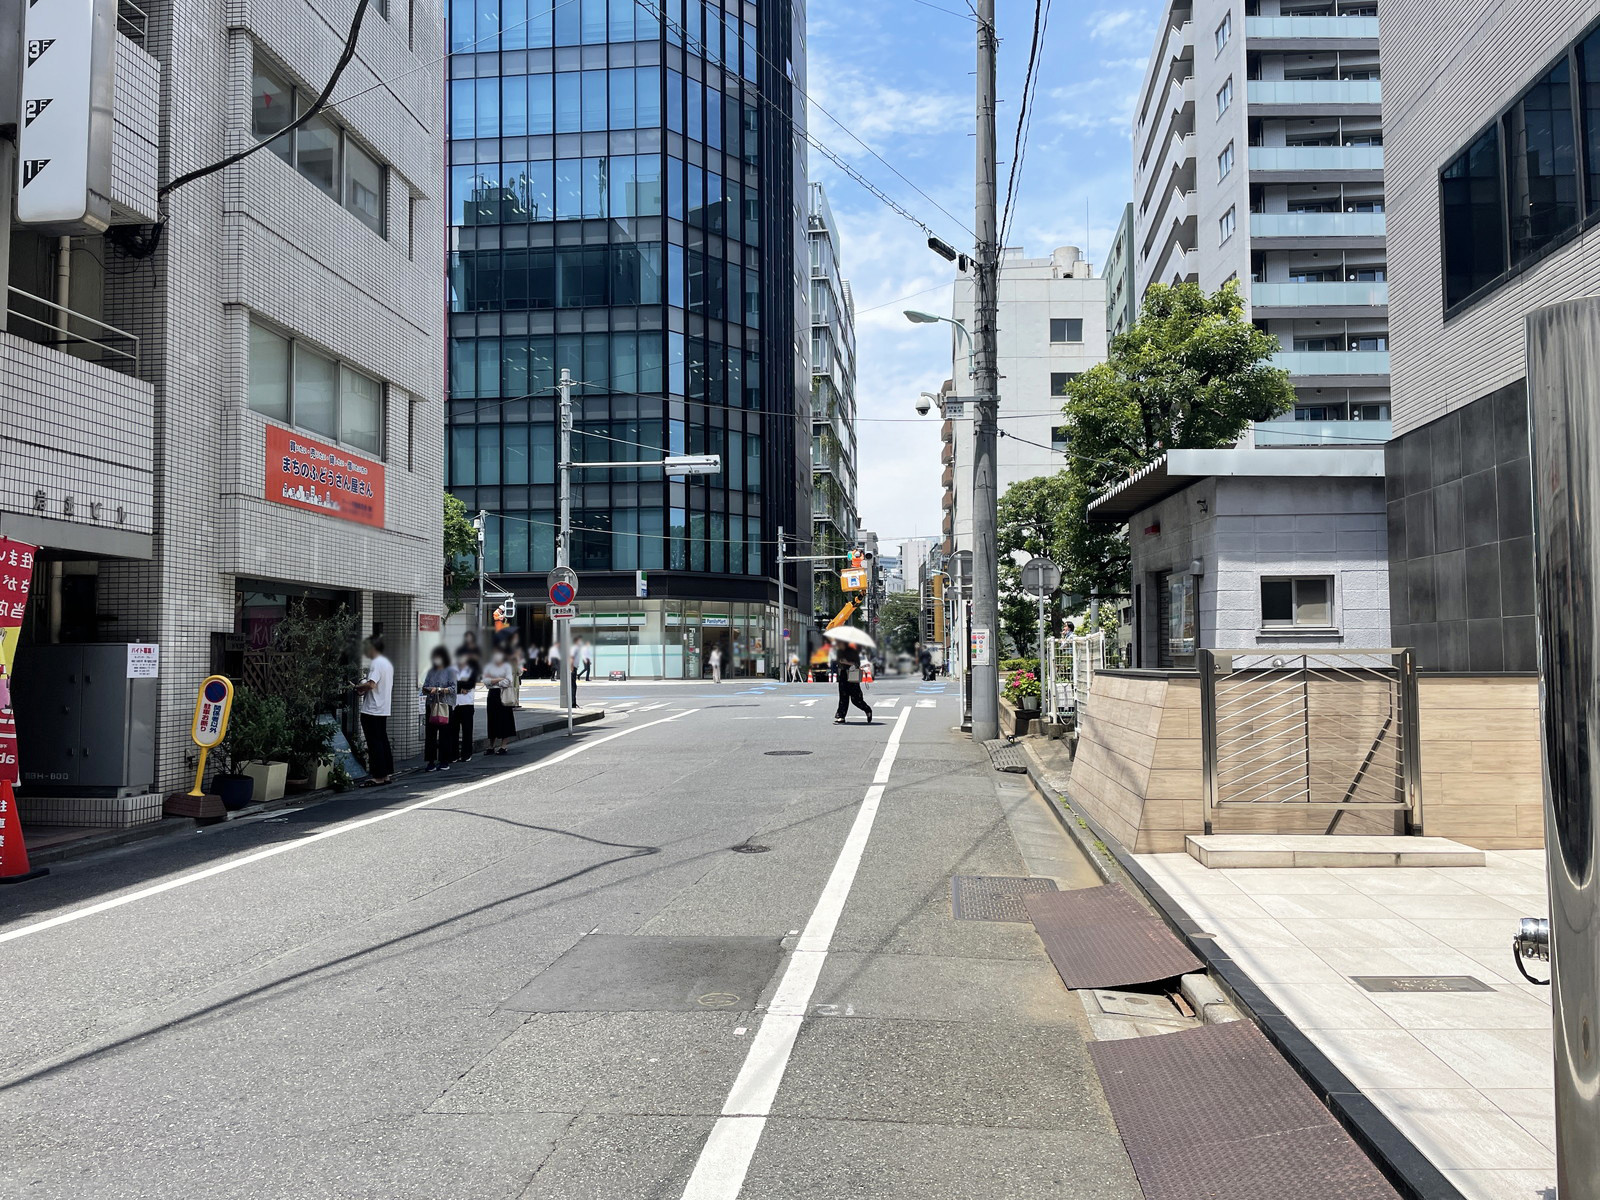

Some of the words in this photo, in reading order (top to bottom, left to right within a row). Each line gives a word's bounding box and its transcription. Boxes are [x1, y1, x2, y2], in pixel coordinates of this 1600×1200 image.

[29, 40, 49, 58] 3F
[26, 99, 47, 118] 2F
[26, 160, 45, 179] 1F
[282, 456, 374, 498] まちのふどうさん屋さん
[200, 703, 211, 732] 駐車お断り
